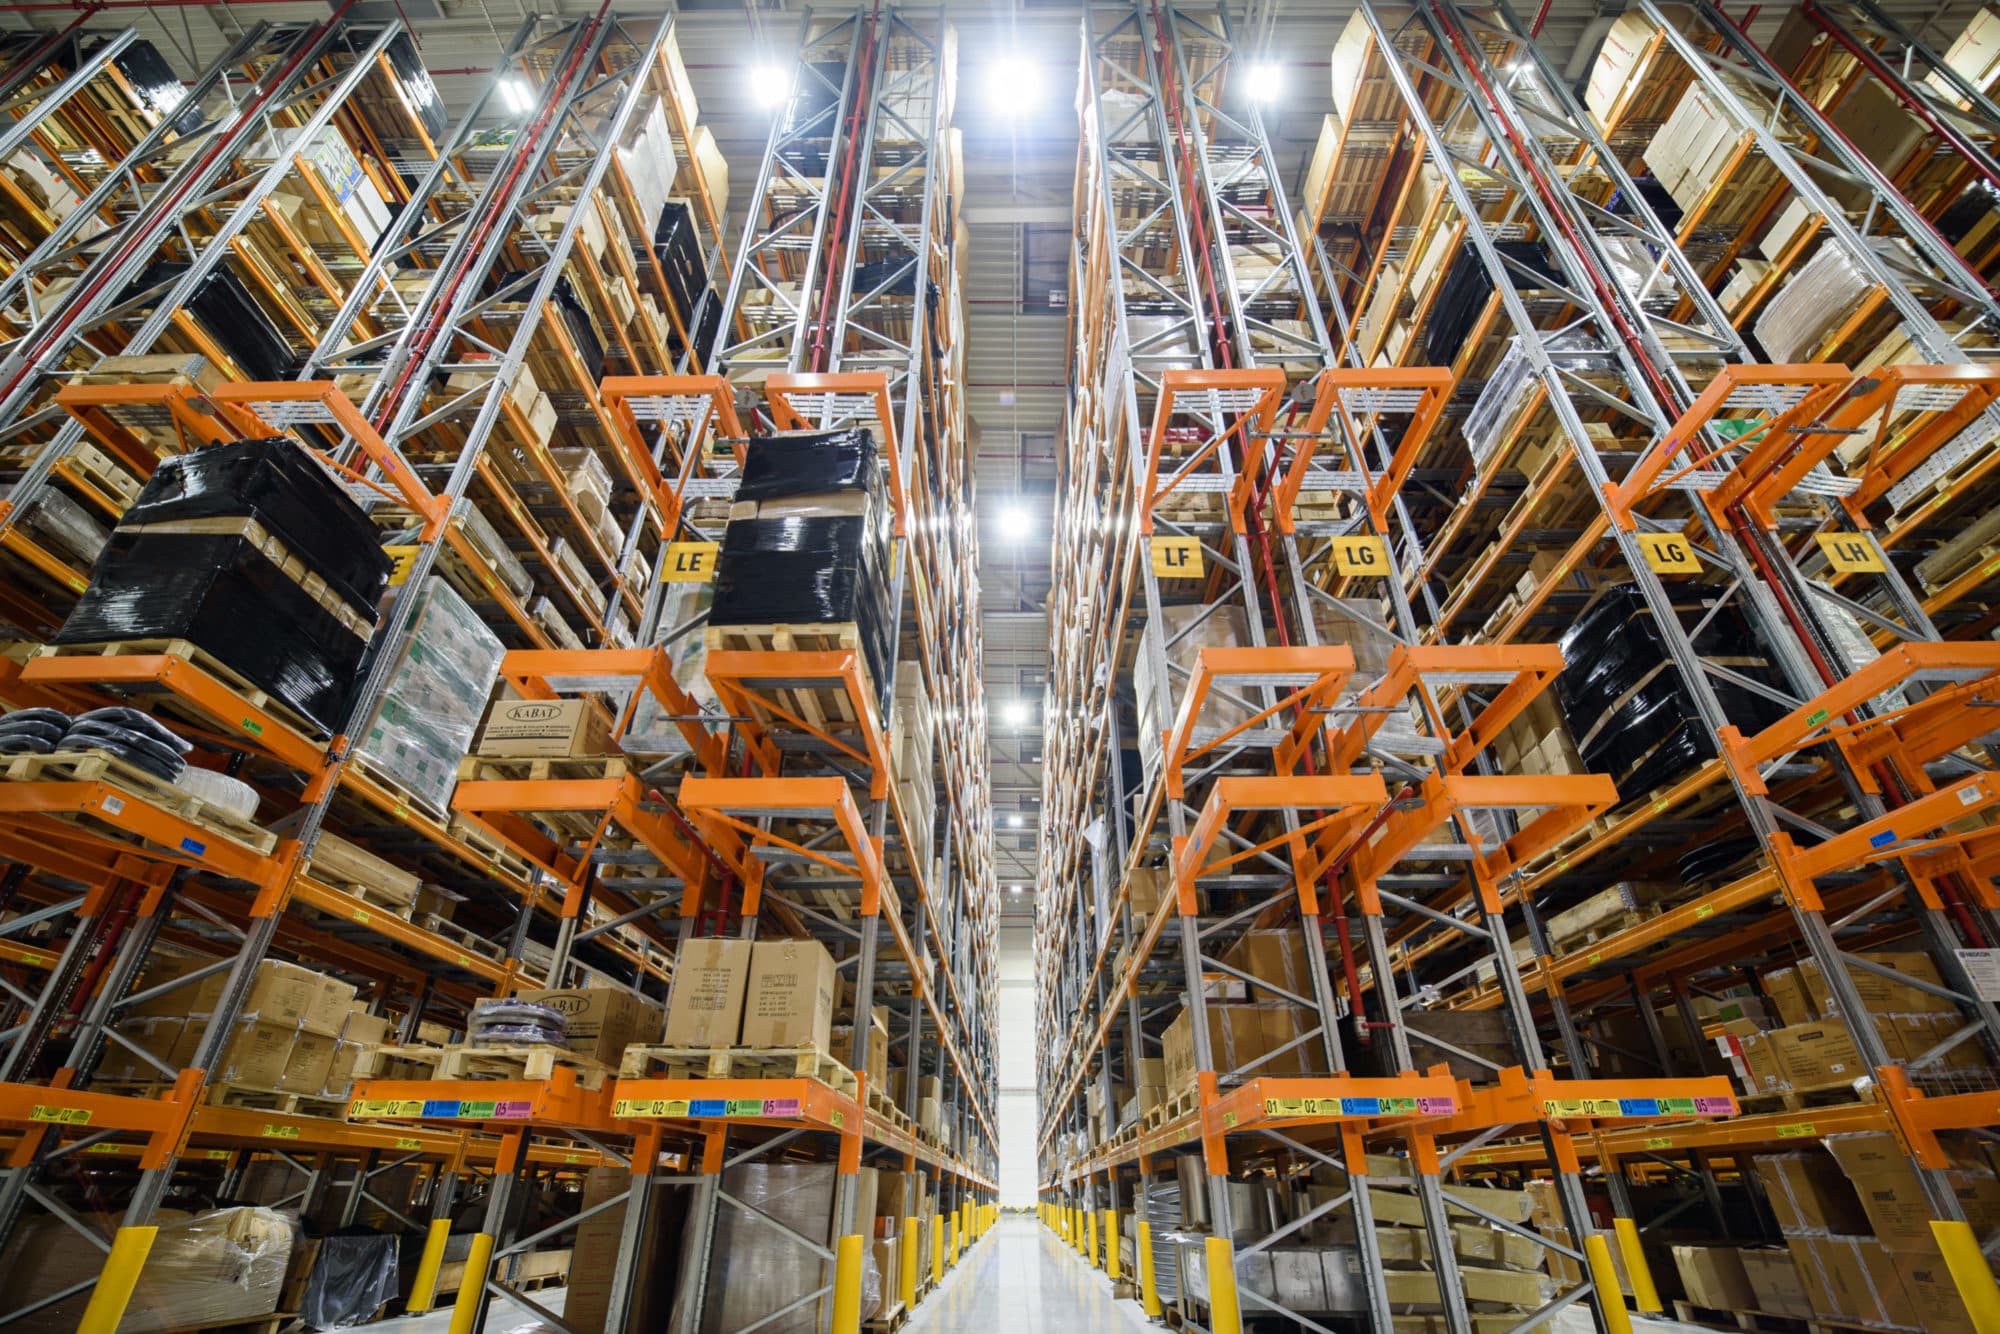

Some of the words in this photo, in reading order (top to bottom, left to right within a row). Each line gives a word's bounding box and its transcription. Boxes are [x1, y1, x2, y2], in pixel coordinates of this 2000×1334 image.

[1164, 547, 1189, 567] LF
[1345, 546, 1375, 566] LG
[1652, 543, 1686, 563] LG
[1832, 542, 1870, 562] LH
[675, 552, 704, 572] LE
[513, 708, 556, 718] KABAT
[30, 1106, 43, 1119] 01
[60, 1109, 73, 1121] 02
[351, 1101, 363, 1115] 01
[387, 1102, 400, 1115] 02
[424, 1102, 435, 1115] 03
[459, 1103, 471, 1116] 04
[495, 1103, 507, 1116] 05
[615, 1101, 627, 1115] 01
[652, 1101, 664, 1115] 02
[689, 1101, 700, 1115] 03
[726, 1101, 737, 1114] 04
[763, 1101, 775, 1114] 05
[1266, 1100, 1278, 1114] 01
[1304, 1100, 1316, 1113] 02
[1342, 1100, 1354, 1113] 03
[1379, 1099, 1391, 1112] 04
[1417, 1098, 1429, 1113] 05
[1545, 1101, 1557, 1114] 01
[1583, 1101, 1596, 1114] 02
[1621, 1101, 1633, 1114] 03
[1658, 1100, 1671, 1114] 04
[1695, 1099, 1708, 1113] 05
